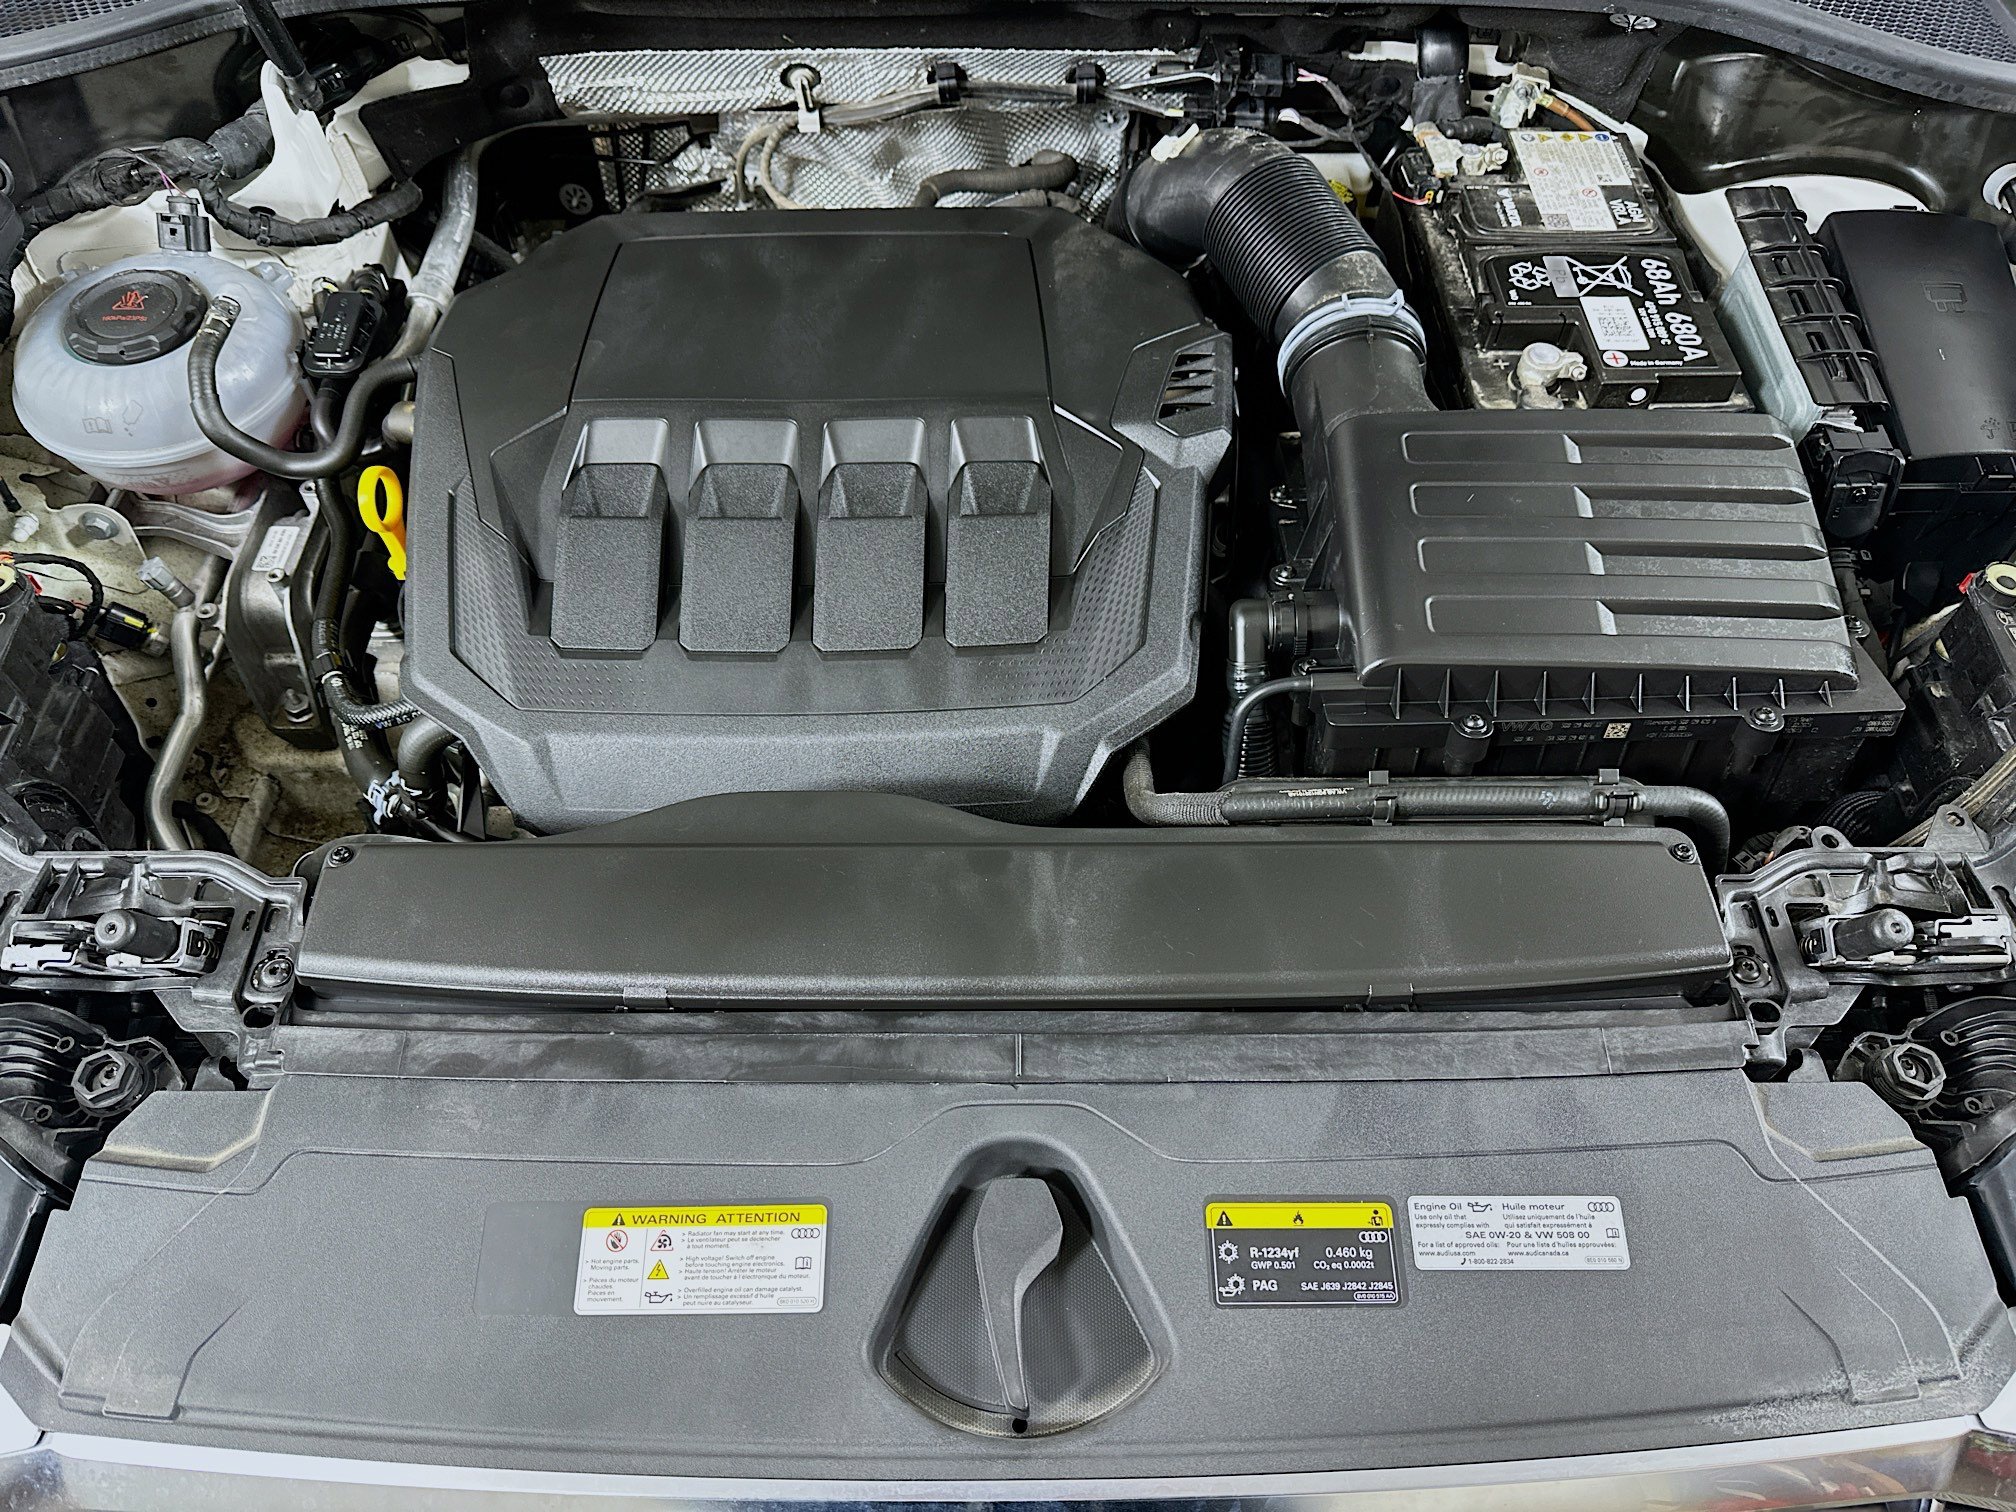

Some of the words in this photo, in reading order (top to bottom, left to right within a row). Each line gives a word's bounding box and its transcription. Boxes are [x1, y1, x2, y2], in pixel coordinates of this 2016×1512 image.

[1609, 199, 1631, 226] VRLA
[1640, 258, 1682, 305] 68Ah
[1664, 311, 1709, 362] 680A
[1414, 1203, 1446, 1212] Engine
[1502, 1203, 1526, 1211] Huile
[1529, 1203, 1565, 1211] moteur
[632, 1214, 707, 1225] WARNING
[716, 1212, 800, 1224] ATTENTION
[1465, 1231, 1486, 1239] SAE
[1488, 1231, 1521, 1239] 0W-20
[1524, 1231, 1532, 1239] &
[1535, 1231, 1554, 1239] VW
[1556, 1231, 1575, 1239] 508
[1577, 1231, 1590, 1239] 00
[1455, 1241, 1485, 1249] approved
[1249, 1247, 1299, 1260] R-1234yf
[1325, 1247, 1356, 1258] 0.460
[1359, 1247, 1373, 1260] kg
[1251, 1261, 1272, 1270] GWP
[1274, 1261, 1296, 1270] 0.501
[1331, 1262, 1343, 1271] eq
[1343, 1261, 1375, 1269] 0.0002t
[1252, 1280, 1278, 1291] PAG
[1301, 1282, 1319, 1291] SAE
[1320, 1282, 1341, 1291] J639
[1342, 1282, 1366, 1291] J2842
[1368, 1281, 1394, 1290] J2845
